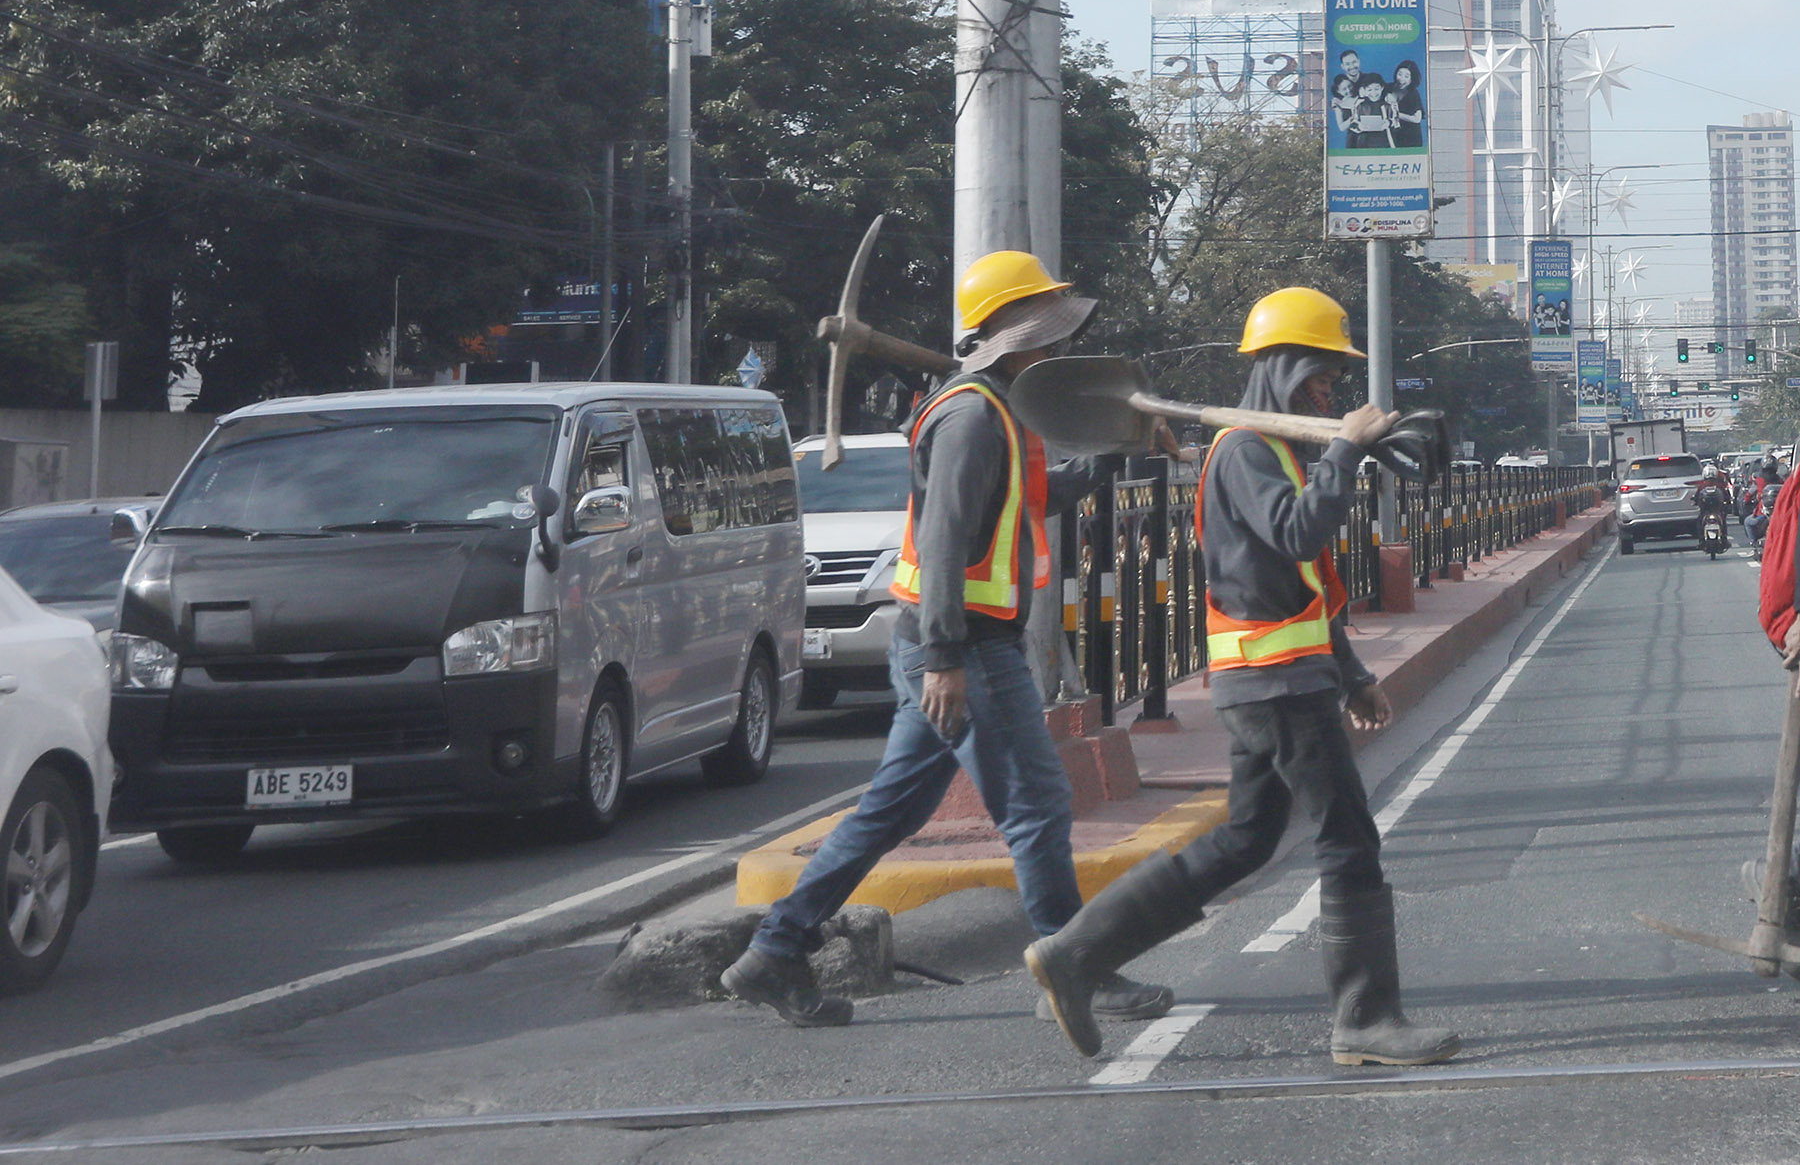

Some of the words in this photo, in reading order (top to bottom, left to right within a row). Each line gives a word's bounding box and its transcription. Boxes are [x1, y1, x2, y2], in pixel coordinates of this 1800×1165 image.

[1341, 163, 1421, 175] EASTERN
[253, 774, 291, 796] ABE
[299, 771, 348, 793] 5249
